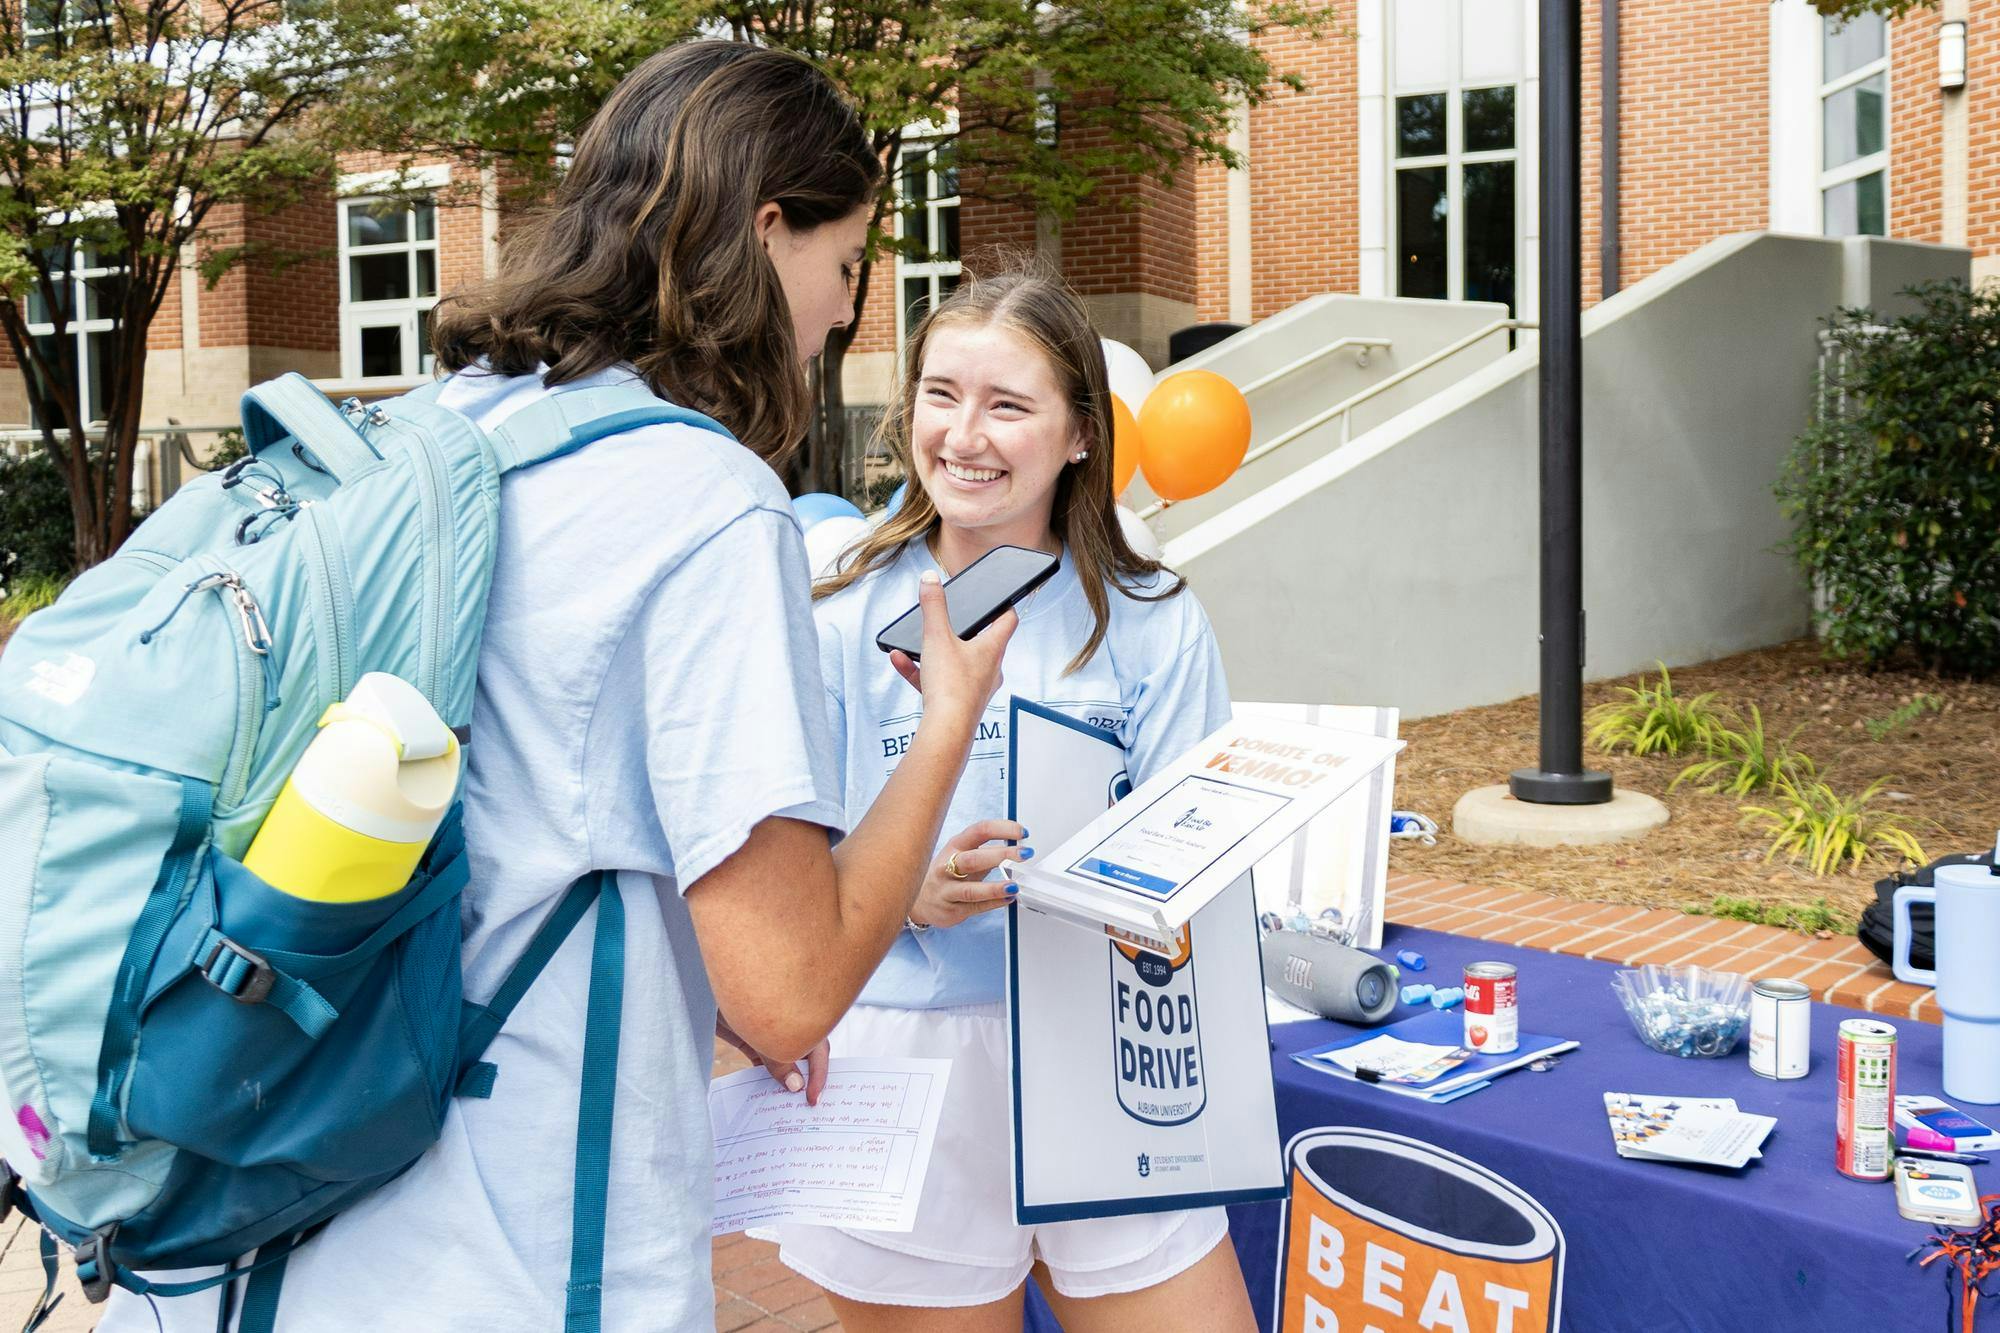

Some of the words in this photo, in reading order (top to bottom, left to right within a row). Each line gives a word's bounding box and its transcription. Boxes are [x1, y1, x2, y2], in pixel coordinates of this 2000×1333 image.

[1205, 752, 1327, 789] VENMO!
[1227, 737, 1312, 760] DONATE
[1312, 753, 1351, 768] ON
[1142, 961, 1153, 974] EST.
[1154, 964, 1167, 975] 1994
[1284, 955, 1313, 990] JBL
[1117, 980, 1193, 1035] FOOD
[1120, 1036, 1198, 1089] DRIVE
[1138, 1101, 1159, 1115] AUBURN
[1307, 1213, 1529, 1333] BEAT
